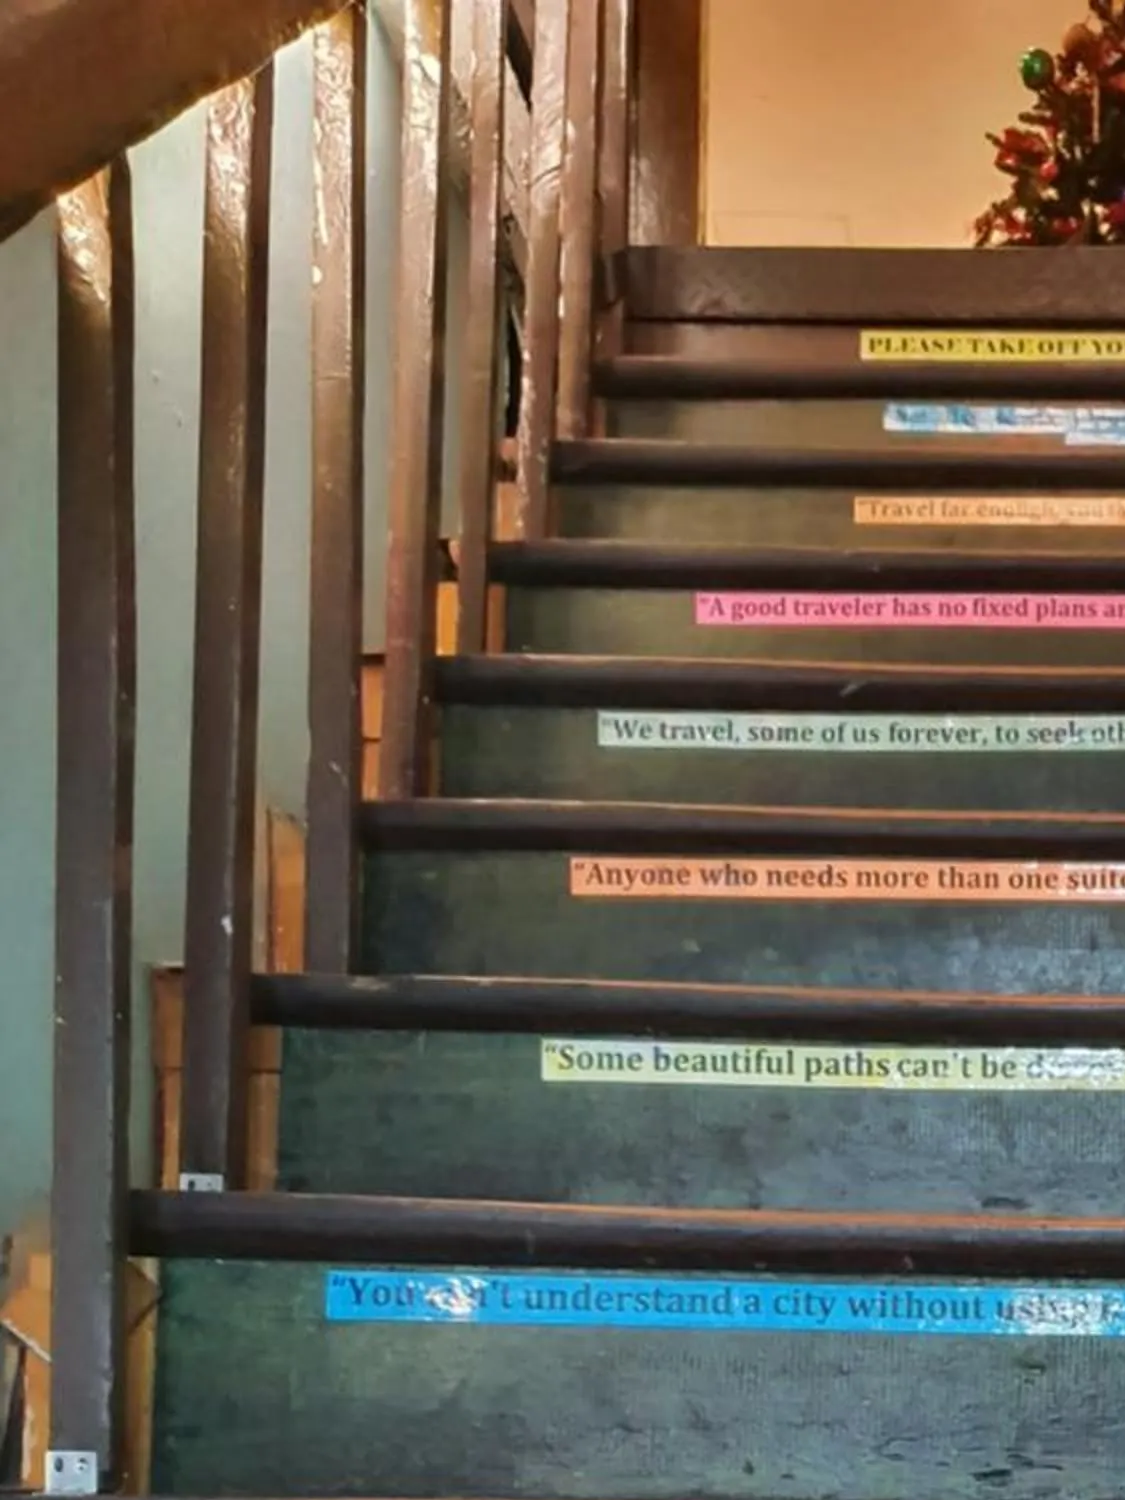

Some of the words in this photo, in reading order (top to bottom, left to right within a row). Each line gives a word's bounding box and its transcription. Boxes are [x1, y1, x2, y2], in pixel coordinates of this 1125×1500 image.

[868, 338, 961, 354] PLEASE
[967, 338, 1034, 355] TAKE
[731, 599, 786, 621] good
[794, 598, 886, 617] traveler
[893, 598, 931, 617] has
[939, 603, 966, 617] no
[973, 598, 1028, 618] fixed
[1036, 598, 1097, 621] plans
[659, 720, 740, 744] travel,
[747, 726, 813, 742] some
[821, 722, 846, 743] of
[852, 727, 879, 743] us
[889, 722, 987, 746] forever,
[995, 725, 1019, 744] to
[1026, 720, 1085, 743] seek
[699, 864, 757, 887] who
[766, 865, 847, 888] needs
[855, 870, 929, 889] more
[937, 866, 1000, 889] than
[1009, 872, 1059, 890] one
[653, 1046, 794, 1075] beautiful
[804, 1050, 890, 1082] paths
[982, 1053, 1017, 1078] be
[524, 1281, 734, 1315] understand
[742, 1297, 760, 1315] a
[773, 1290, 834, 1325] city
[846, 1290, 987, 1321] without
